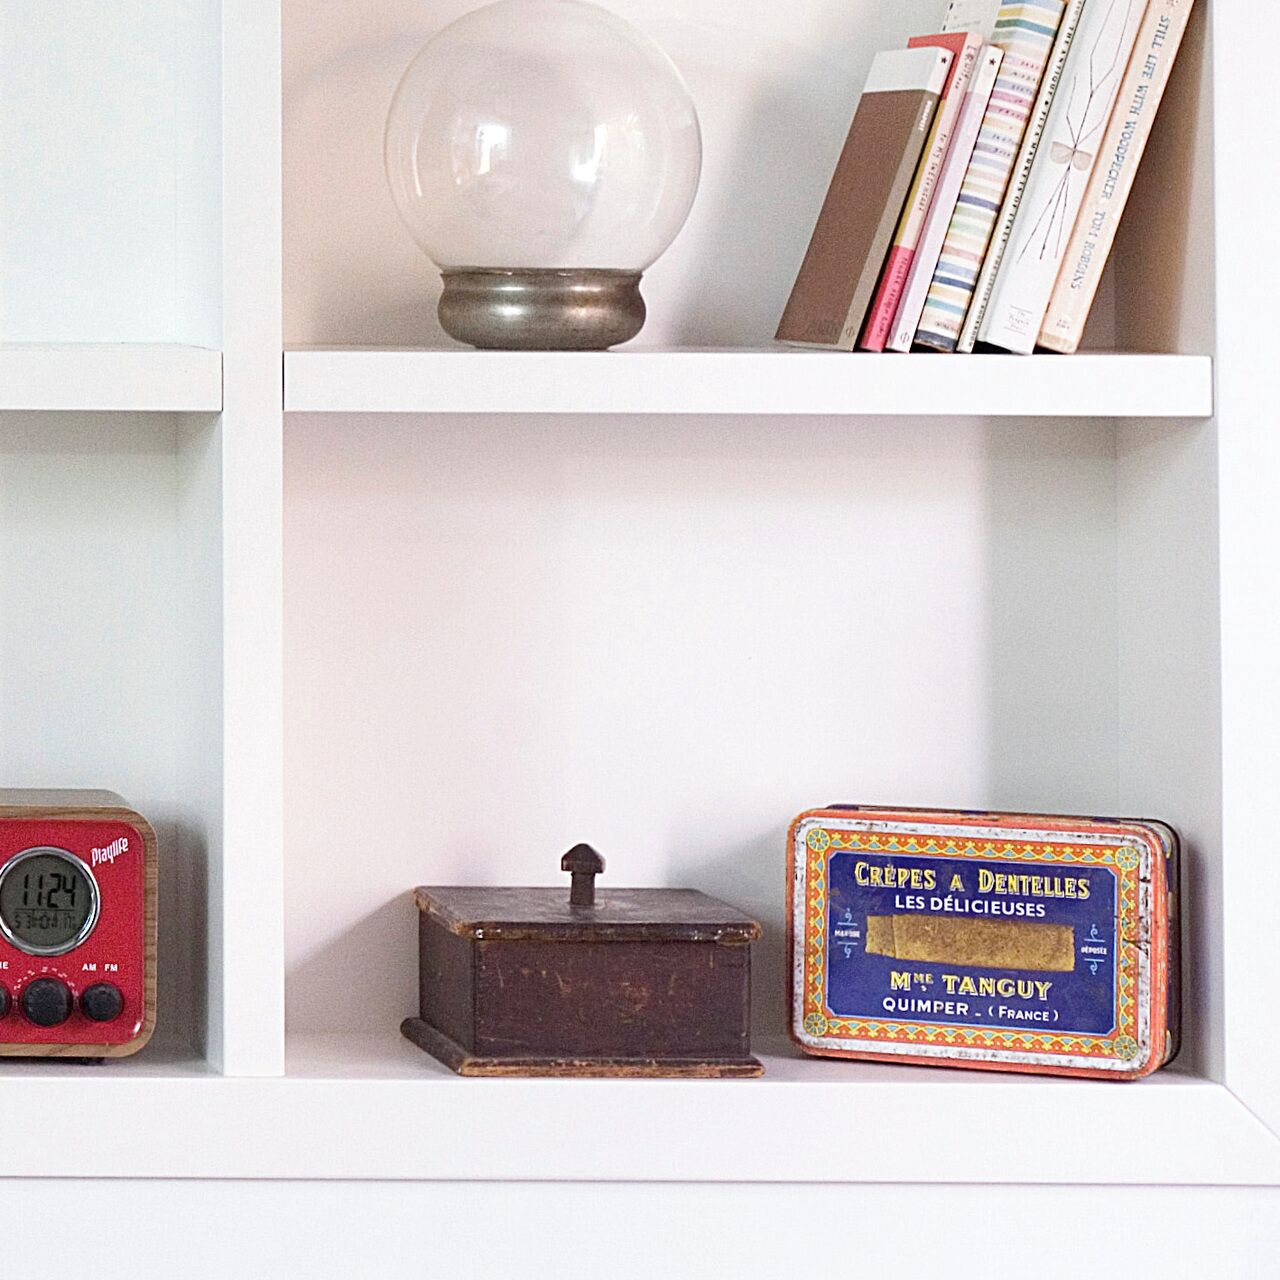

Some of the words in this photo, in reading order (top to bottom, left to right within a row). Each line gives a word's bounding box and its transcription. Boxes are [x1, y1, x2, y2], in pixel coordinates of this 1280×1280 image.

[1063, 25, 1073, 45] THE
[1150, 14, 1171, 50] STILL
[1046, 48, 1066, 96] ANTIQUE
[1140, 53, 1158, 79] LIFE
[1128, 82, 1148, 116] WITH
[1100, 118, 1137, 201] WOODPECKER
[1087, 209, 1106, 238] TOM
[1069, 240, 1095, 291] ROBBINS
[91, 837, 129, 867] Playlife
[950, 873, 965, 892] A
[895, 895, 925, 910] LES
[930, 894, 1046, 918] DÉLICIEUSES
[82, 963, 97, 972] AM
[104, 963, 118, 972] FM
[942, 974, 1052, 1001] TANGUY
[882, 997, 969, 1016] QUIMPER
